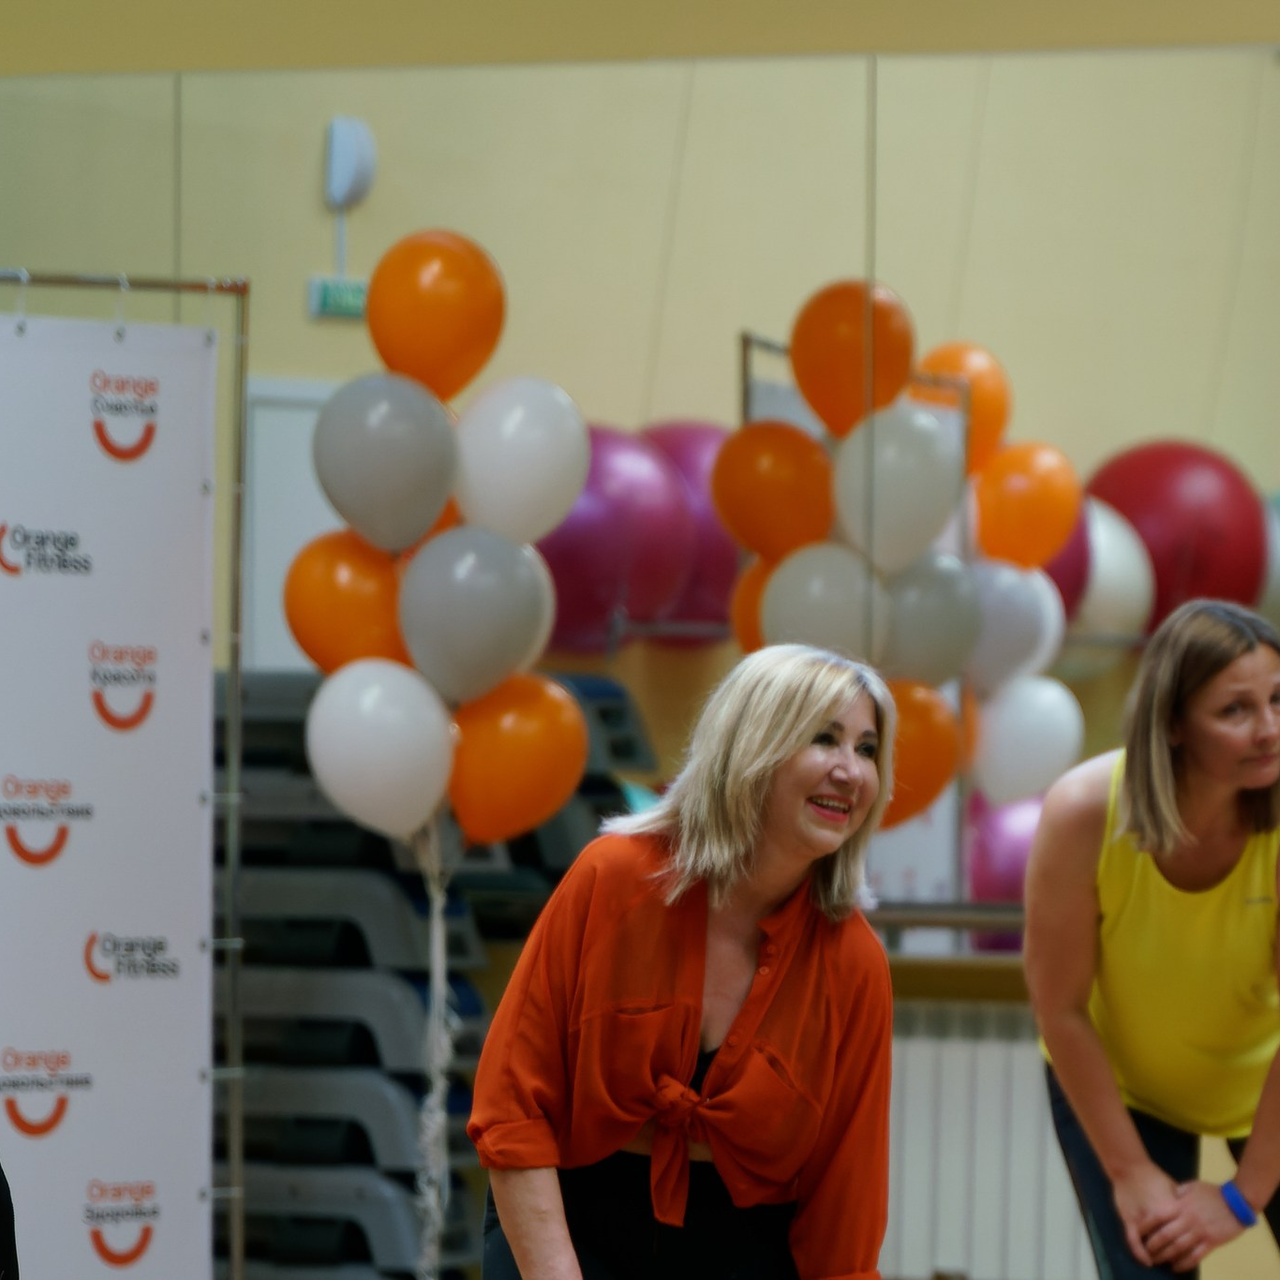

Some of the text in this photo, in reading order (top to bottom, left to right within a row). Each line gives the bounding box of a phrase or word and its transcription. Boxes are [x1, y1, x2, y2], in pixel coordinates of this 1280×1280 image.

[90, 369, 158, 400] Orange
[10, 525, 78, 553] Orange
[26, 551, 92, 573] Fitness
[89, 640, 157, 669] Orange
[3, 775, 71, 804] Orange
[101, 931, 168, 958] Orange
[115, 957, 180, 977] Fitness
[3, 1047, 70, 1075] Orange
[88, 1180, 156, 1205] Orange
